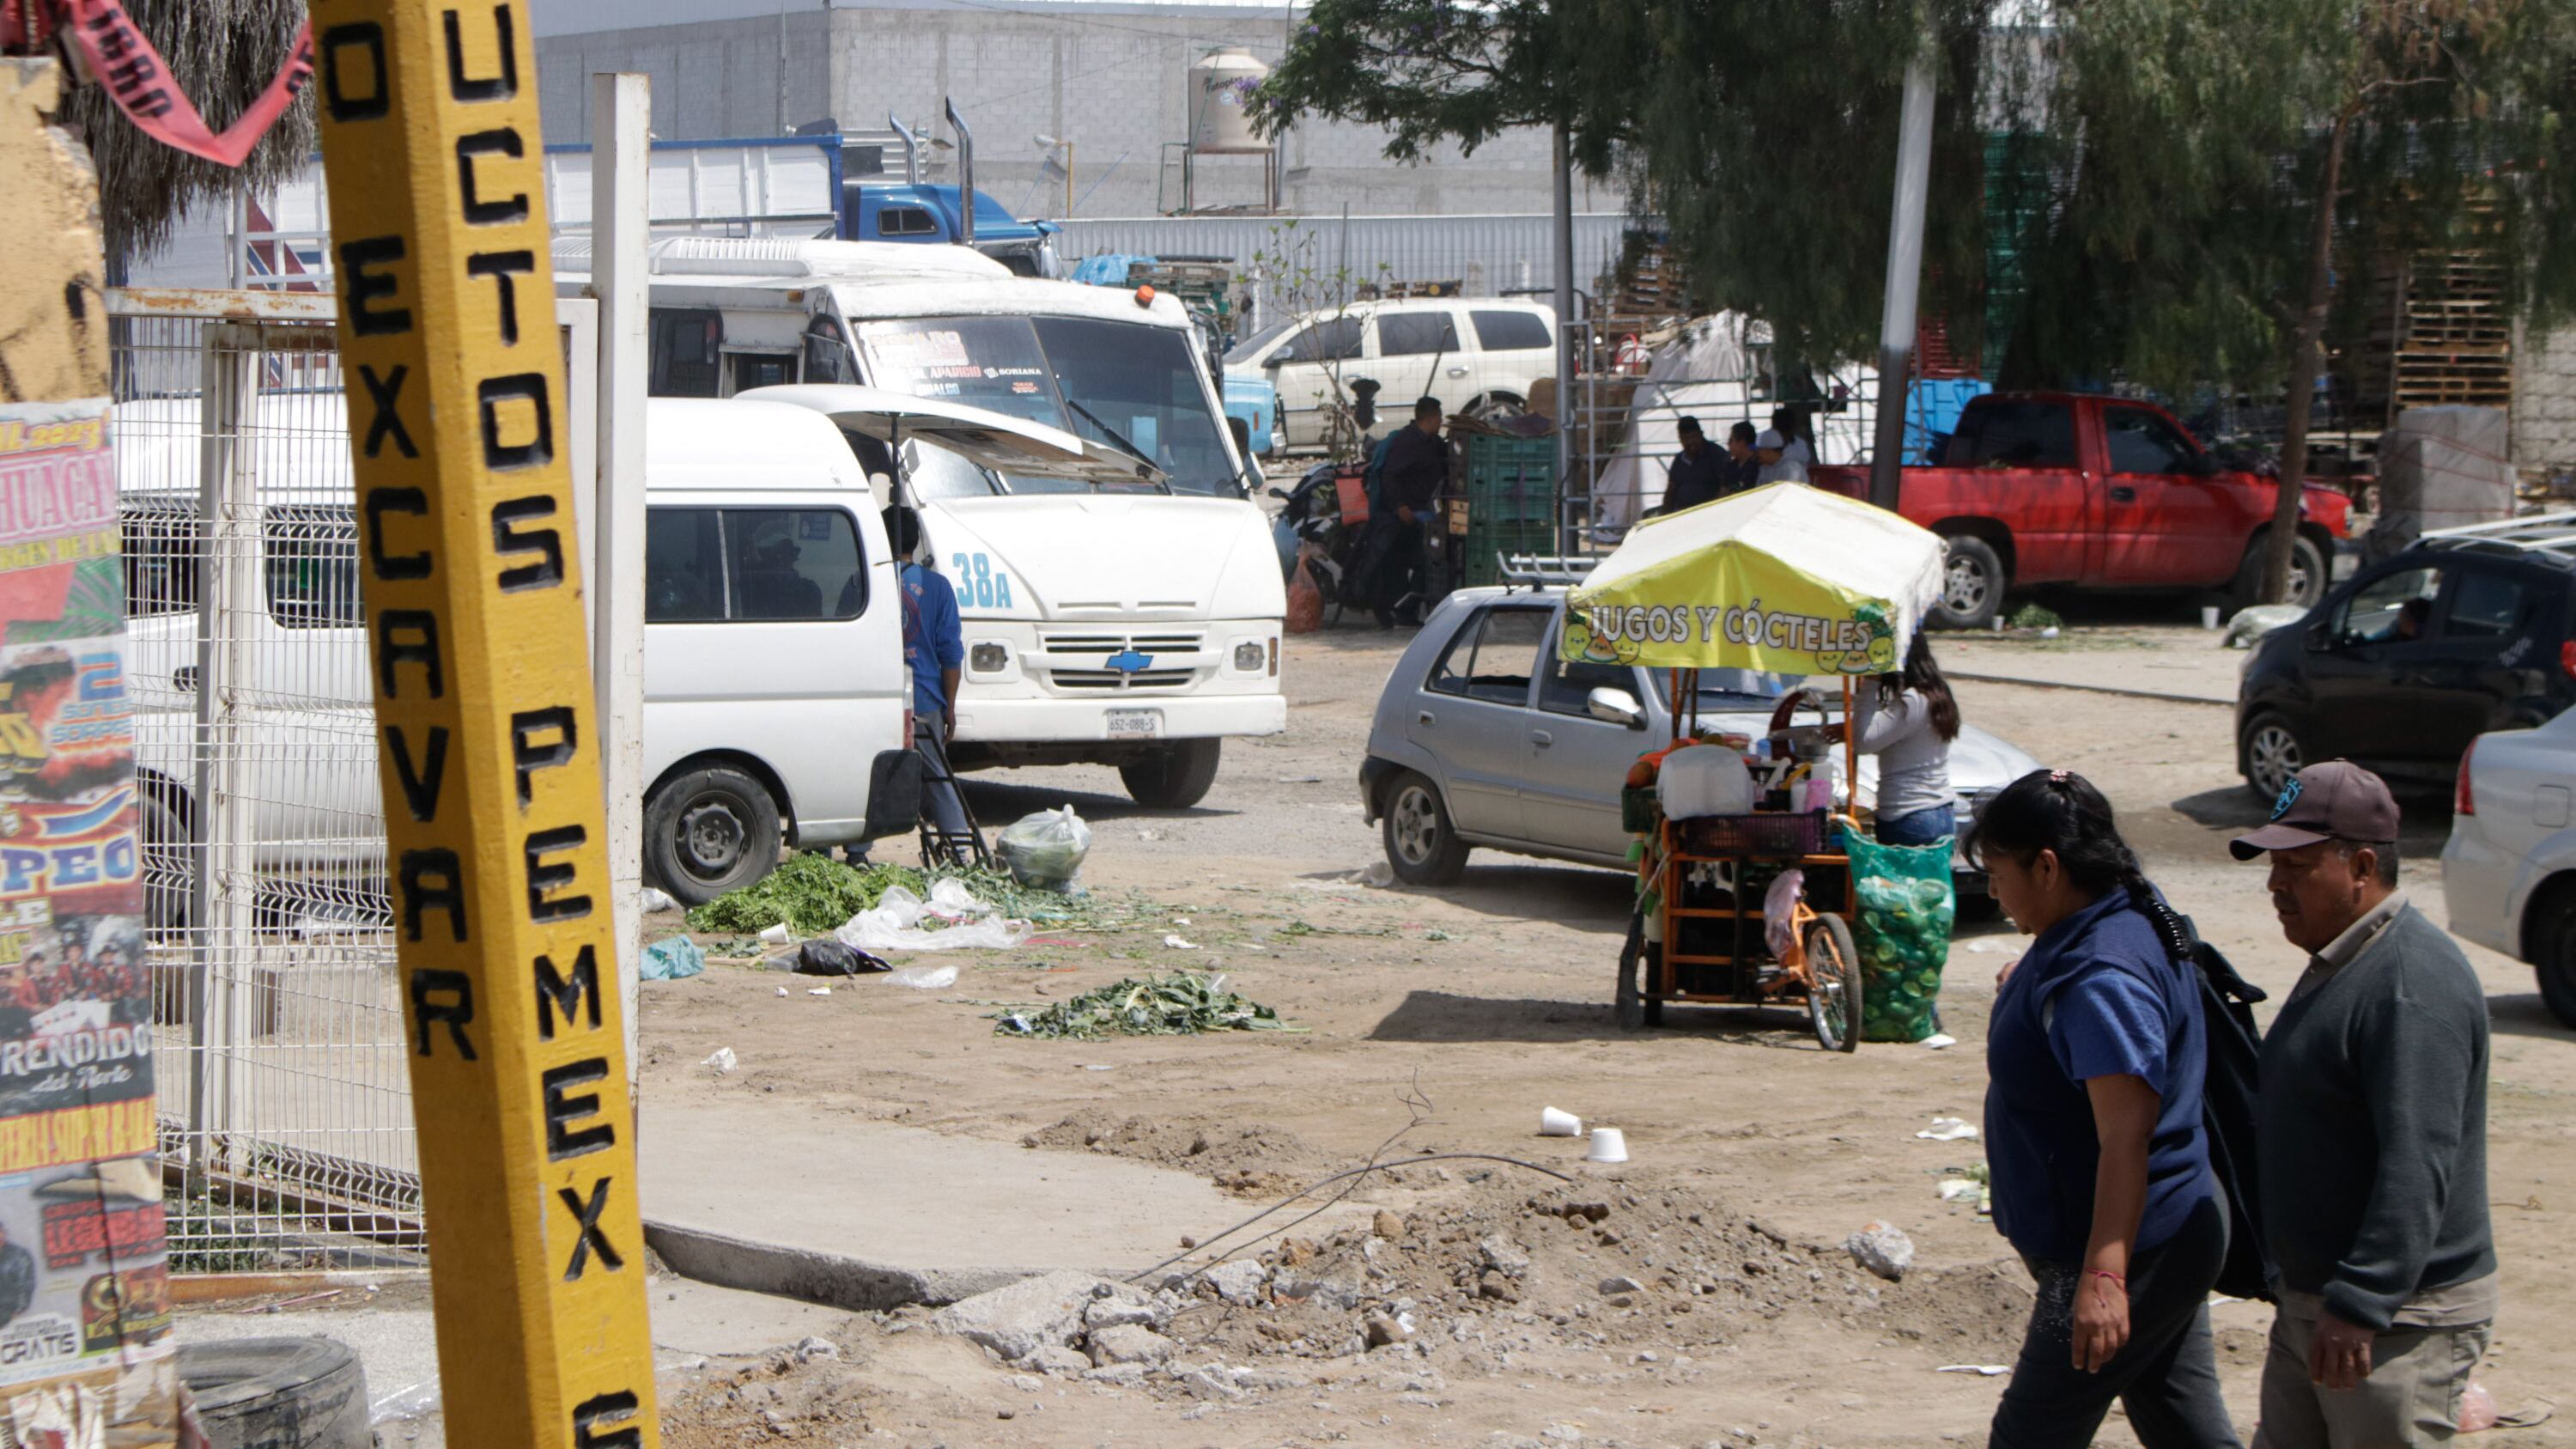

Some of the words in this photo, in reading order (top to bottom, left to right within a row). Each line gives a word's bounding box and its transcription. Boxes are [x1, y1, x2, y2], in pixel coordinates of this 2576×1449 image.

[930, 365, 982, 379] APARICIO
[952, 552, 1012, 609] 38A
[340, 235, 477, 1061] EXCAVAR
[442, 3, 564, 594] UCTOS
[511, 705, 624, 1282] PEMEX
[1589, 604, 1690, 644] JUGOS
[1696, 605, 1720, 642] Y
[1722, 596, 1873, 653] CÓCTELES
